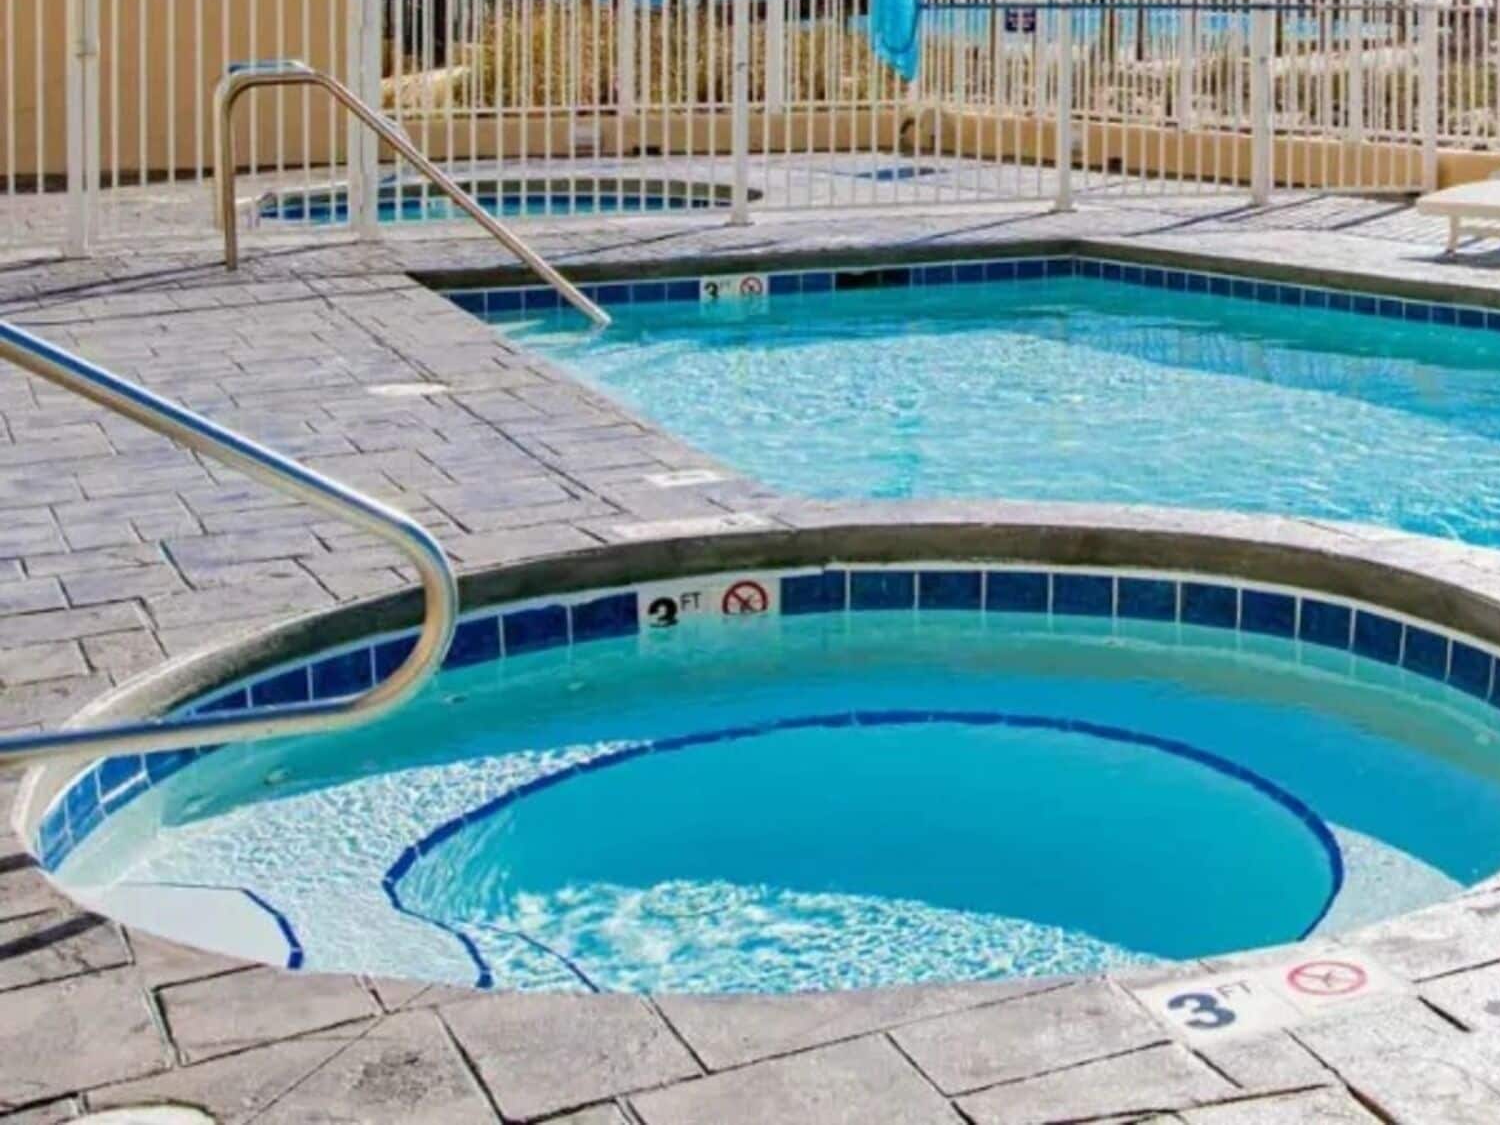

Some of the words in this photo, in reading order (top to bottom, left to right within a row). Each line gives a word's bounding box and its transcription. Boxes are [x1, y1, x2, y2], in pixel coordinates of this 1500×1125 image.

[680, 592, 702, 610] FT
[1167, 993, 1236, 1029] 3
[1217, 979, 1252, 997] FT
